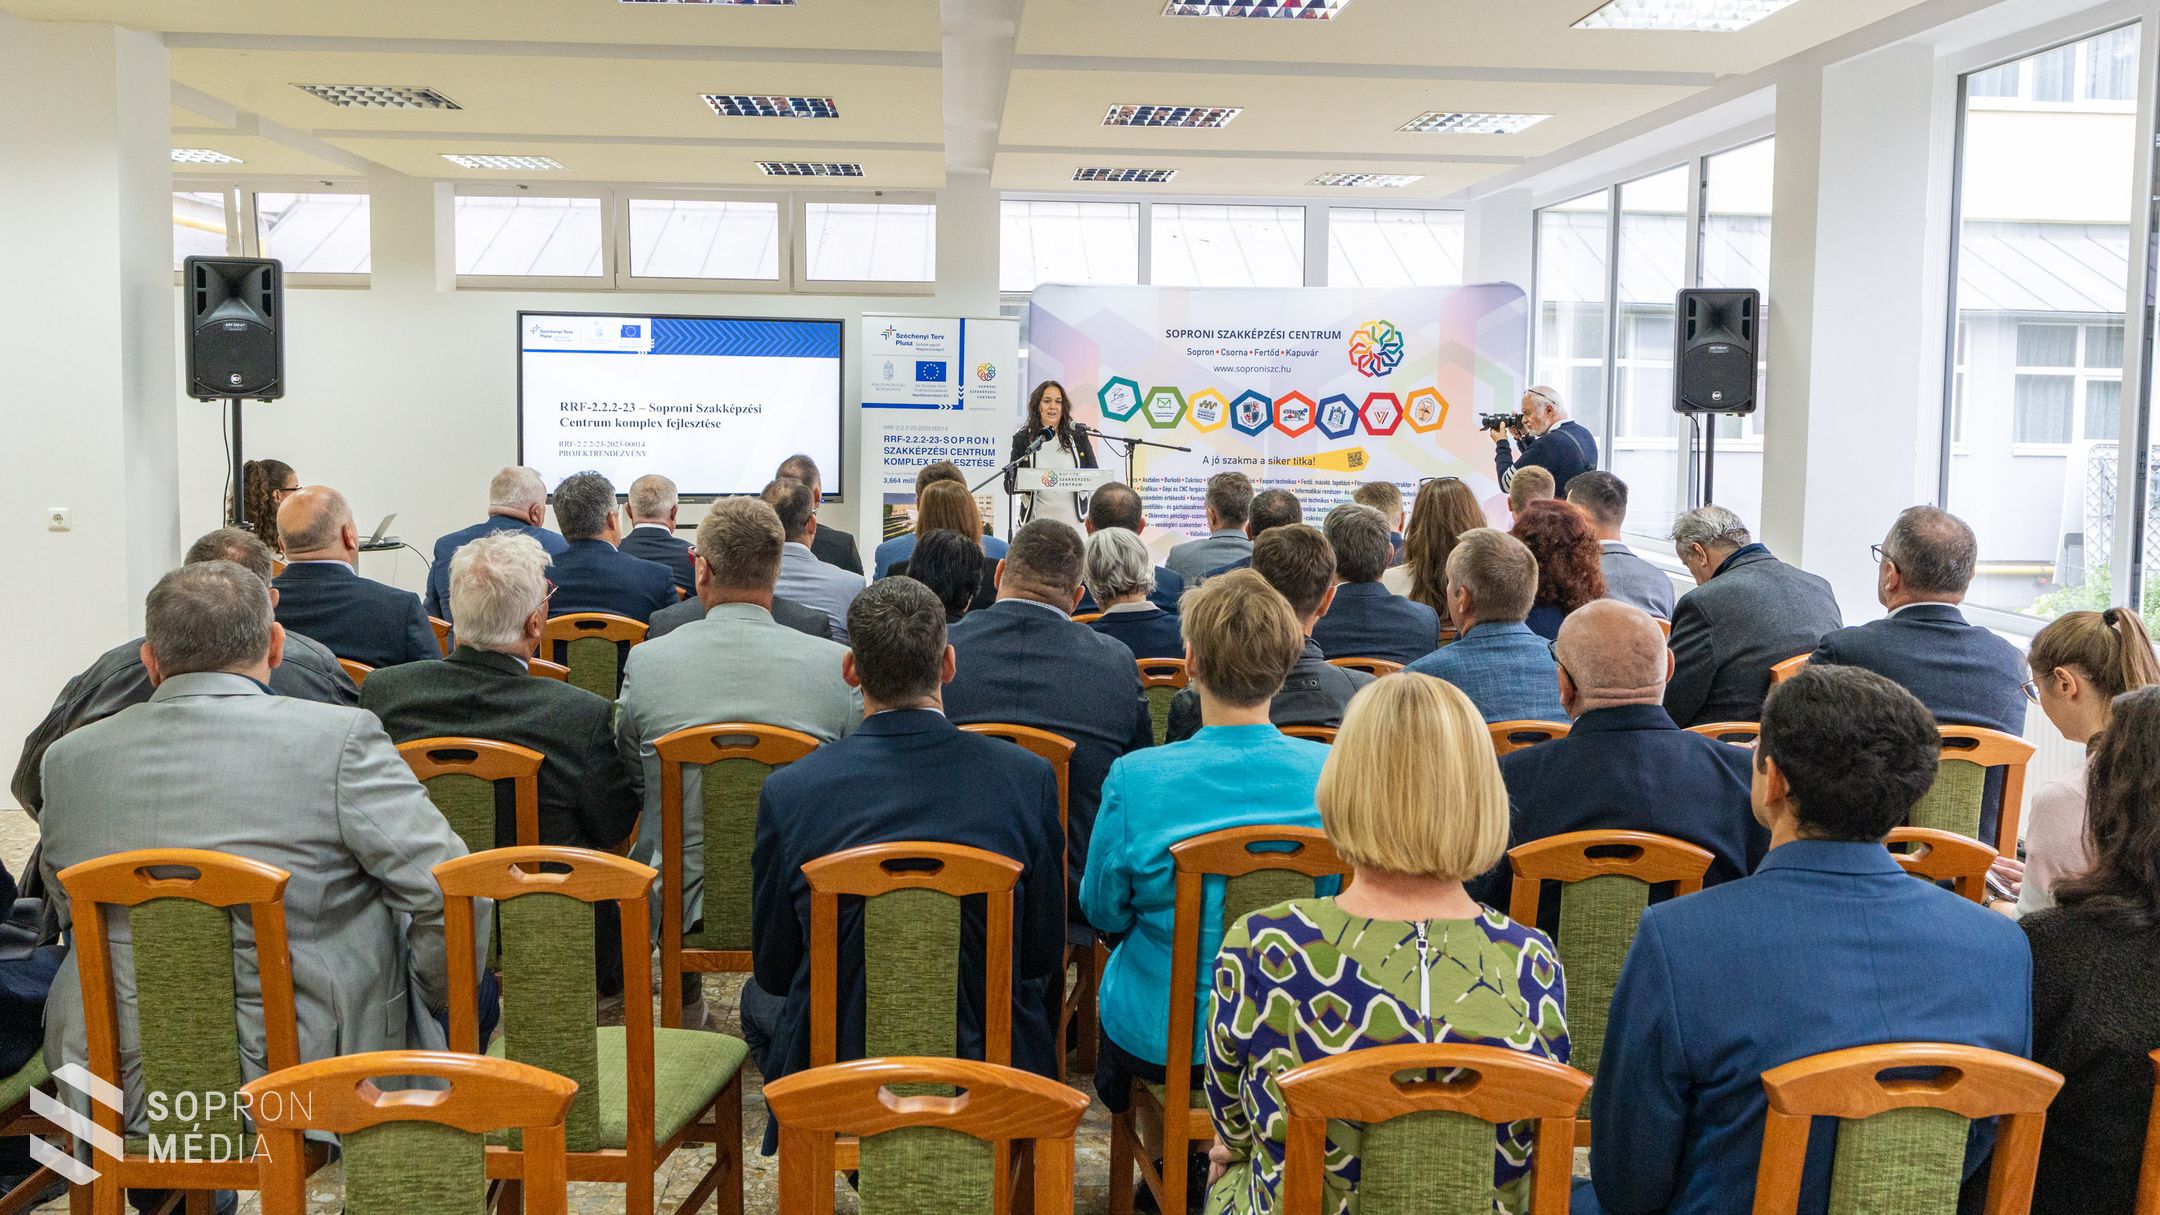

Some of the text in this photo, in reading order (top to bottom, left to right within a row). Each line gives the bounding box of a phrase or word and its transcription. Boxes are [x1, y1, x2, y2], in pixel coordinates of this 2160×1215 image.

[1166, 329, 1341, 340] SOPRONI SZAKKÉPZÉSI CENTRUM
[1187, 348, 1319, 358] Sopron Csorna Fertőd Kapuvár
[1214, 365, 1291, 374] www.soproniszc.hu
[560, 401, 636, 413] RRF-2.2.2-23
[649, 402, 693, 416] Soproni
[696, 402, 762, 416] Szakképzési
[560, 418, 722, 430] Centrum komplex fejlesztése
[558, 449, 647, 457] PROJEKTRENDEZVÉNY
[884, 446, 995, 456] SZAKKÉPZÉSI CENTRUM
[1211, 456, 1219, 466] jó
[1222, 456, 1258, 465] szakma
[1268, 457, 1290, 465] siker
[1293, 457, 1315, 466] titka!
